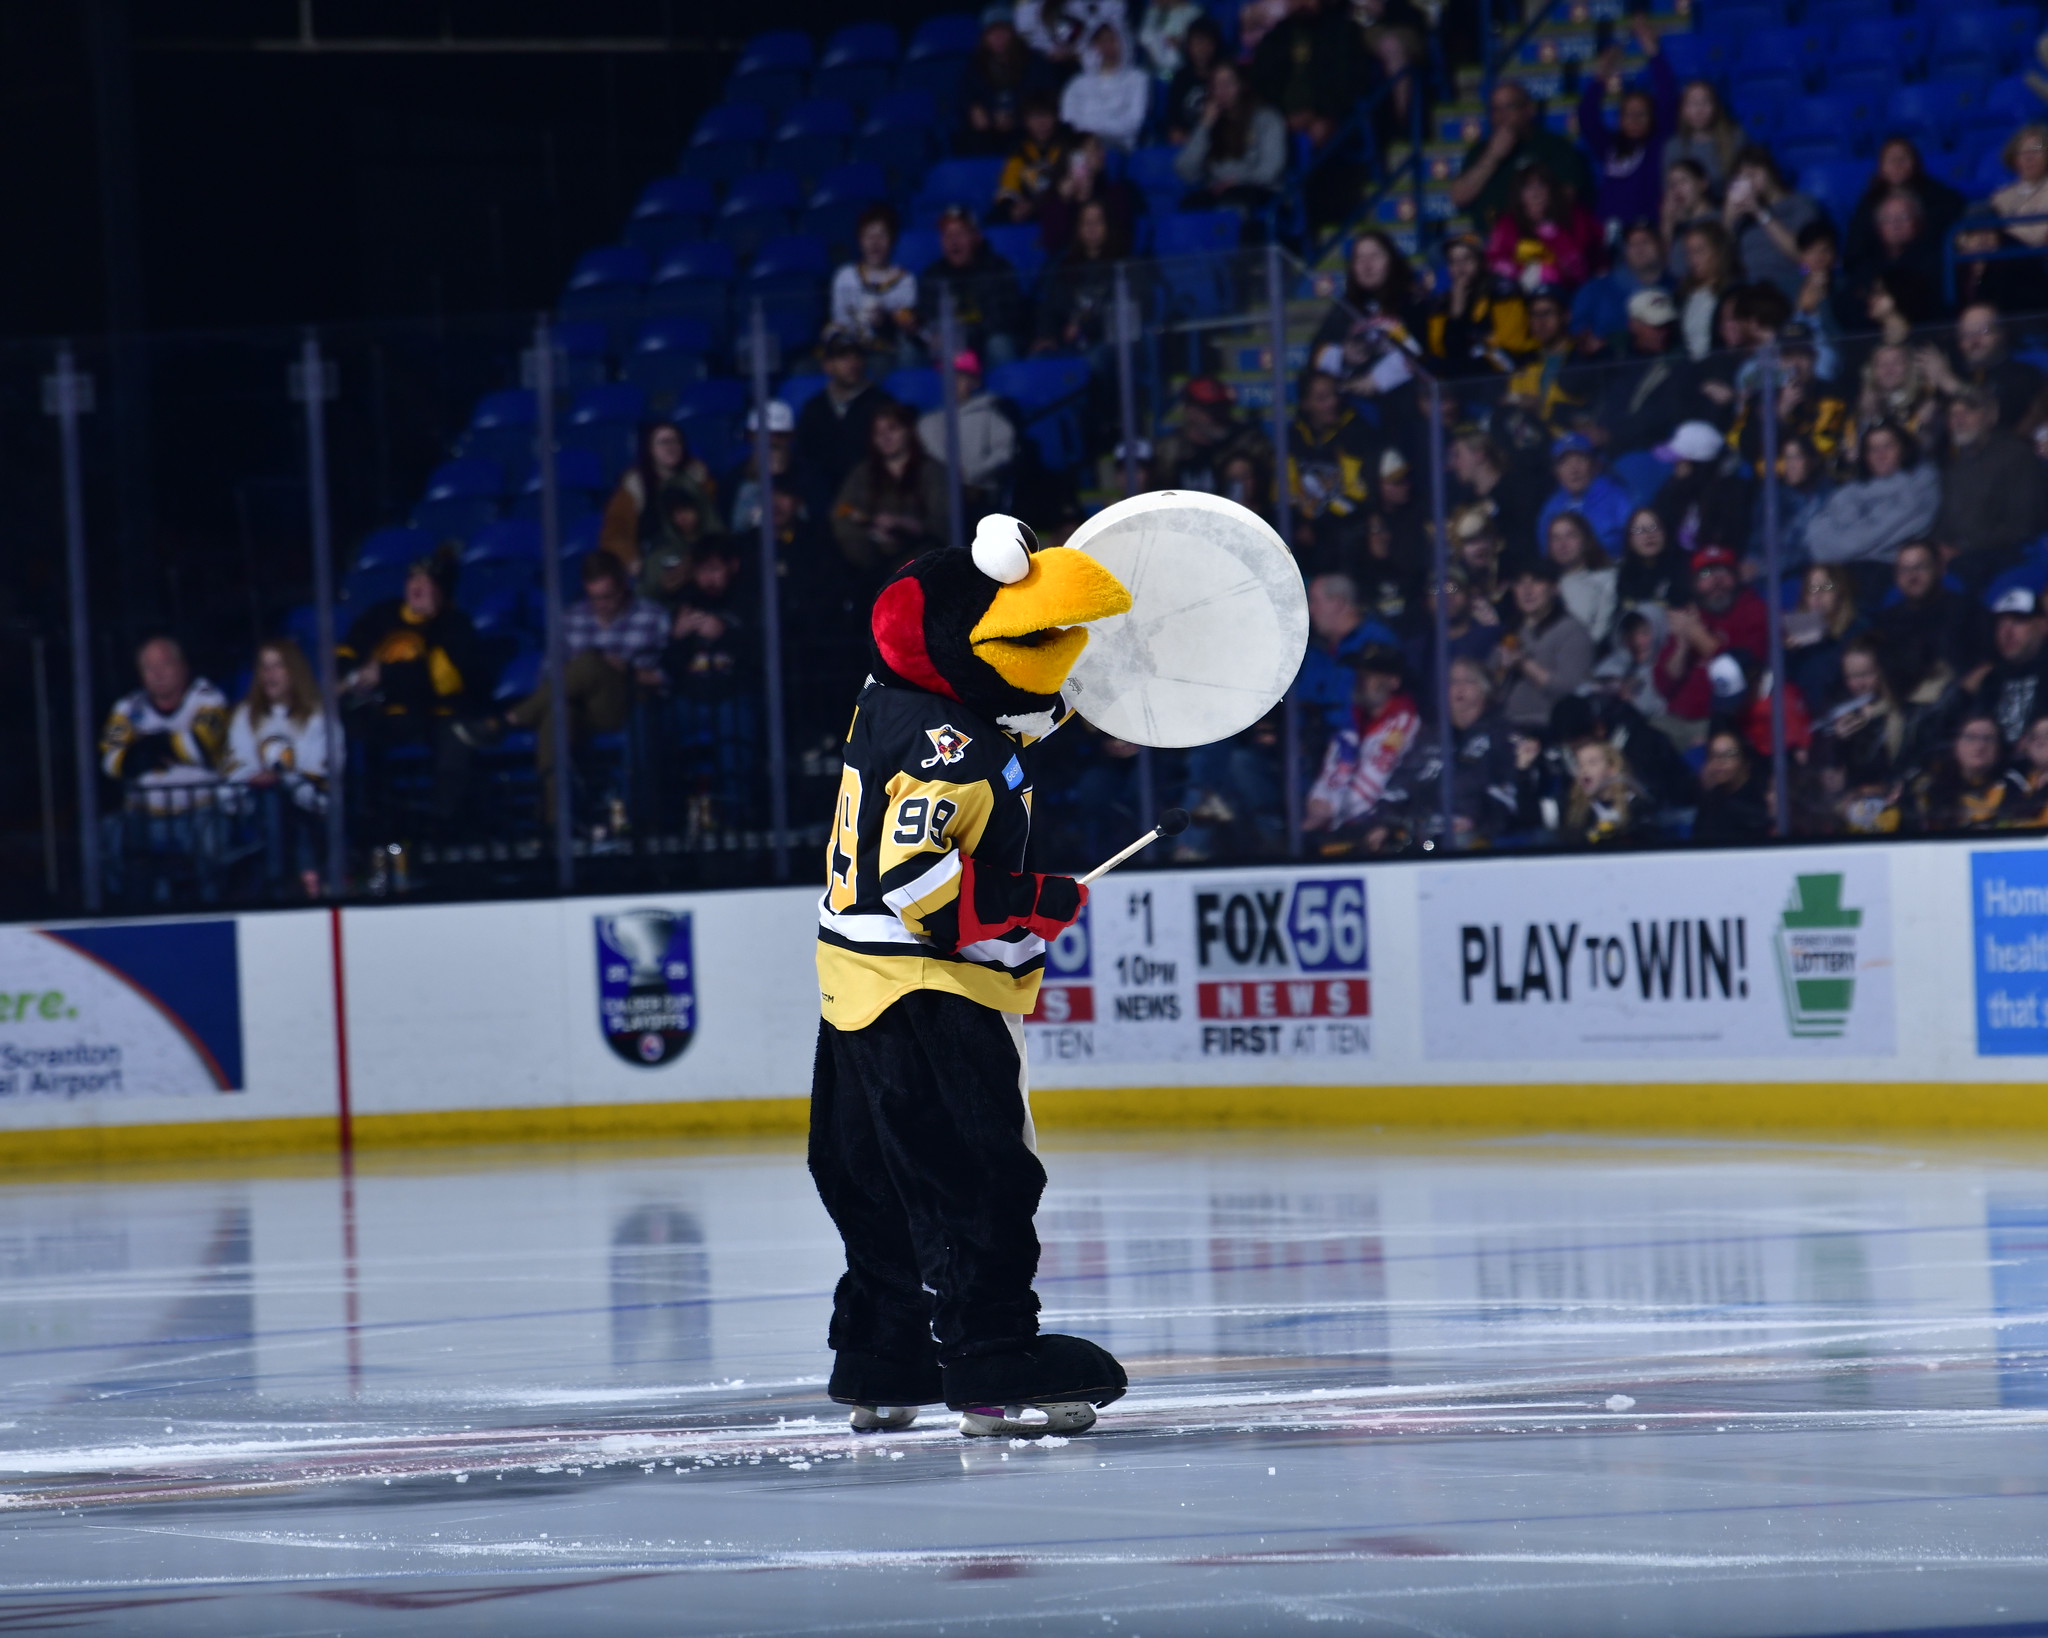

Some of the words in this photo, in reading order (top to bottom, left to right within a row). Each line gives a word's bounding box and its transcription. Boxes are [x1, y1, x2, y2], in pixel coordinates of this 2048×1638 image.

[893, 797, 958, 850] 99
[1129, 890, 1154, 946] #1
[1193, 890, 1290, 967] FOX
[1295, 885, 1367, 967] 56
[1461, 922, 1580, 1004] PLAY
[1632, 917, 1749, 1001] WIN!
[1793, 951, 1855, 973] LOTTERY
[1115, 994, 1181, 1022] NEWS
[1217, 982, 1352, 1018] NEWS
[1987, 988, 2039, 1030] that
[0, 1041, 122, 1070] Scranton
[1043, 1028, 1094, 1059] TEN
[1202, 1026, 1283, 1056] FIRST
[1292, 1027, 1318, 1053] AT
[1326, 1024, 1370, 1055] TEN
[29, 1069, 124, 1101] Airport
